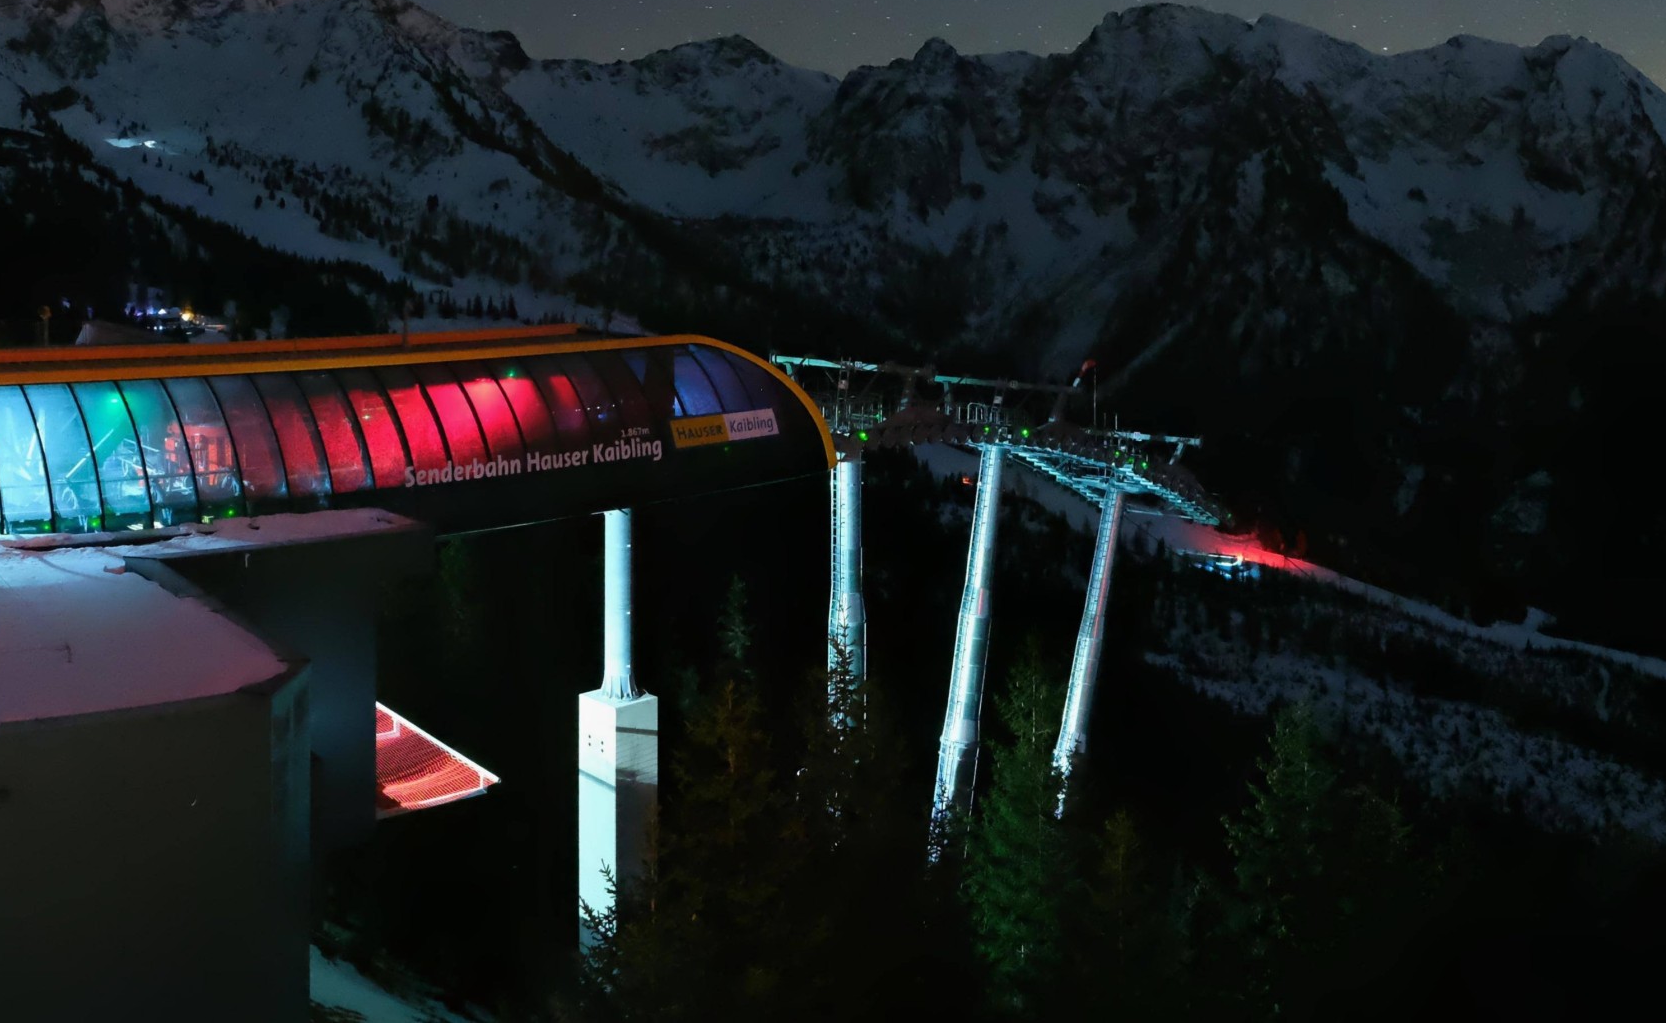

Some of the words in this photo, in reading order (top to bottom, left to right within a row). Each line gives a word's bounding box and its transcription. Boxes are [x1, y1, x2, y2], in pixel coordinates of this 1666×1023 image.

[676, 425, 723, 440] HAUSER
[729, 416, 774, 433] Kaibling
[404, 455, 521, 487] Senderbahn
[526, 449, 589, 472] Hauser
[593, 438, 662, 463] Kaibling
